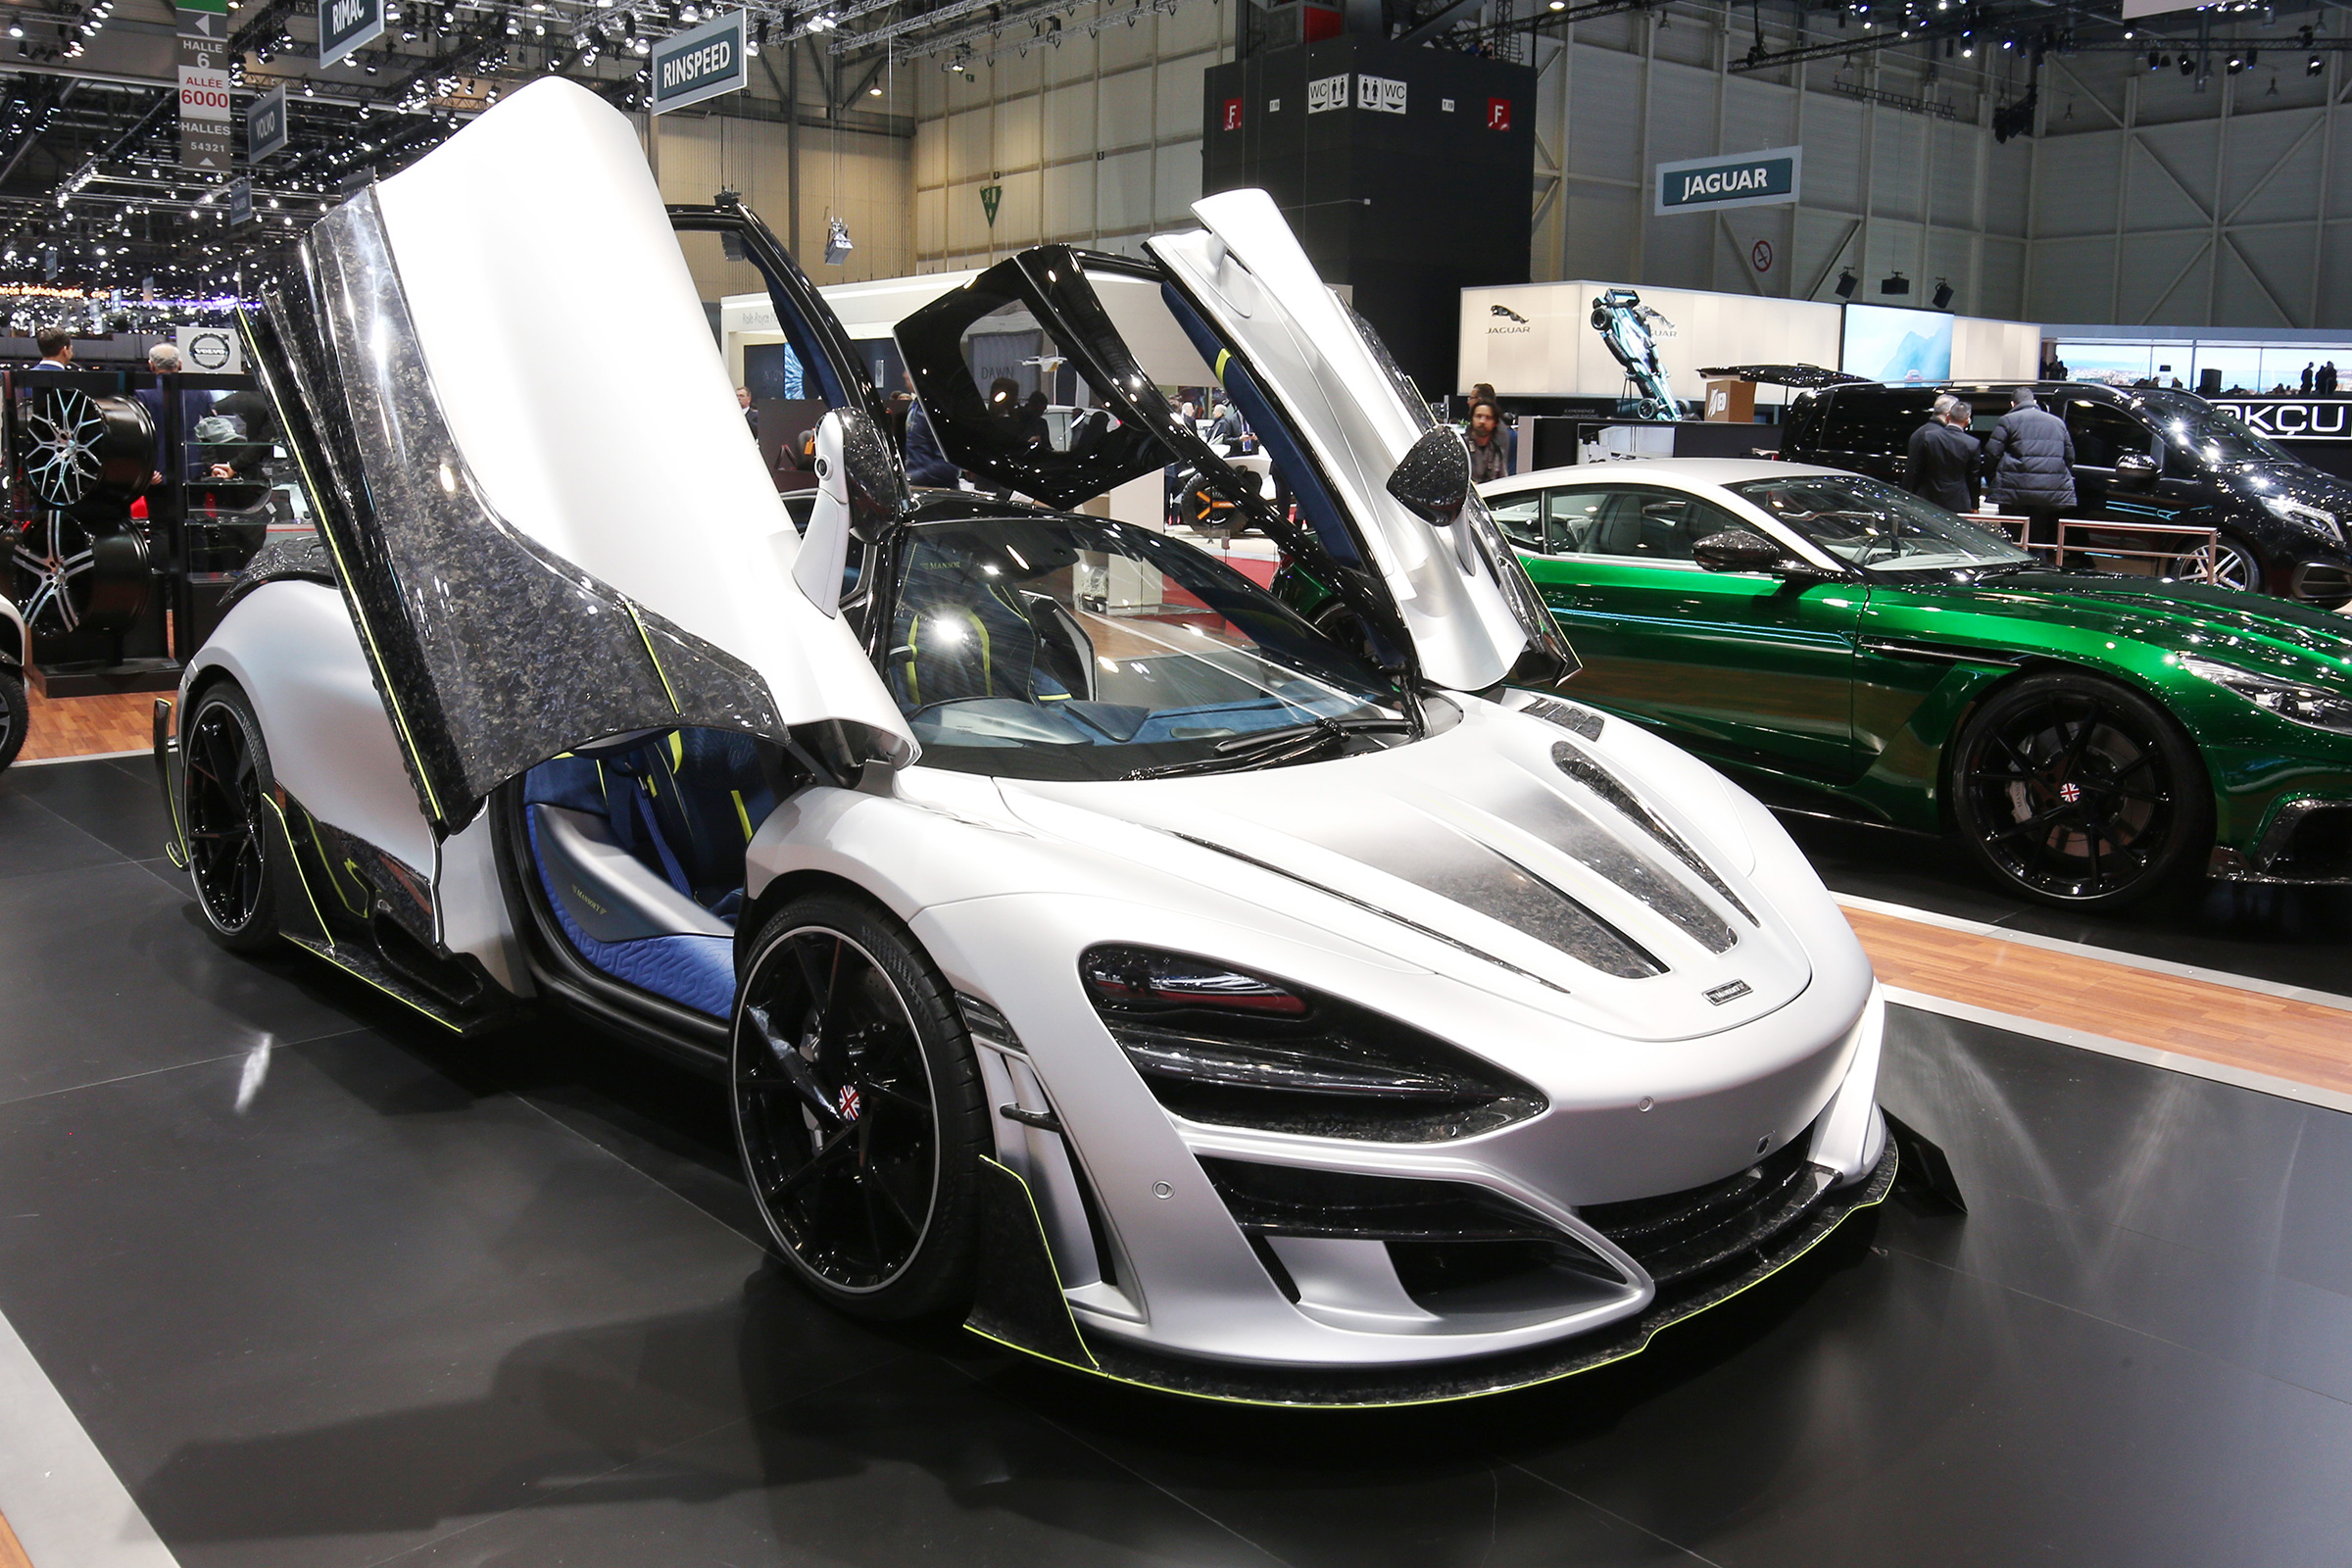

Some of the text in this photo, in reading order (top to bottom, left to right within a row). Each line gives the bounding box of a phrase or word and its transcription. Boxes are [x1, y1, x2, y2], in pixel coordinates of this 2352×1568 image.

[332, 0, 365, 35] RIMAC
[182, 40, 223, 54] HALLE
[197, 52, 210, 70] 6
[663, 40, 730, 89] RINSPEED
[186, 76, 223, 89] ALLÉE
[1310, 82, 1328, 99] WC
[1385, 83, 1405, 99] WC
[181, 89, 228, 109] 6000
[1229, 105, 1237, 123] F
[1494, 105, 1503, 123] F
[181, 122, 231, 135] HALLES
[256, 111, 275, 140] VOLVO
[1682, 168, 1768, 202] JAGUAR
[1485, 326, 1531, 335] JAGUAR
[982, 366, 1014, 379] DAWN
